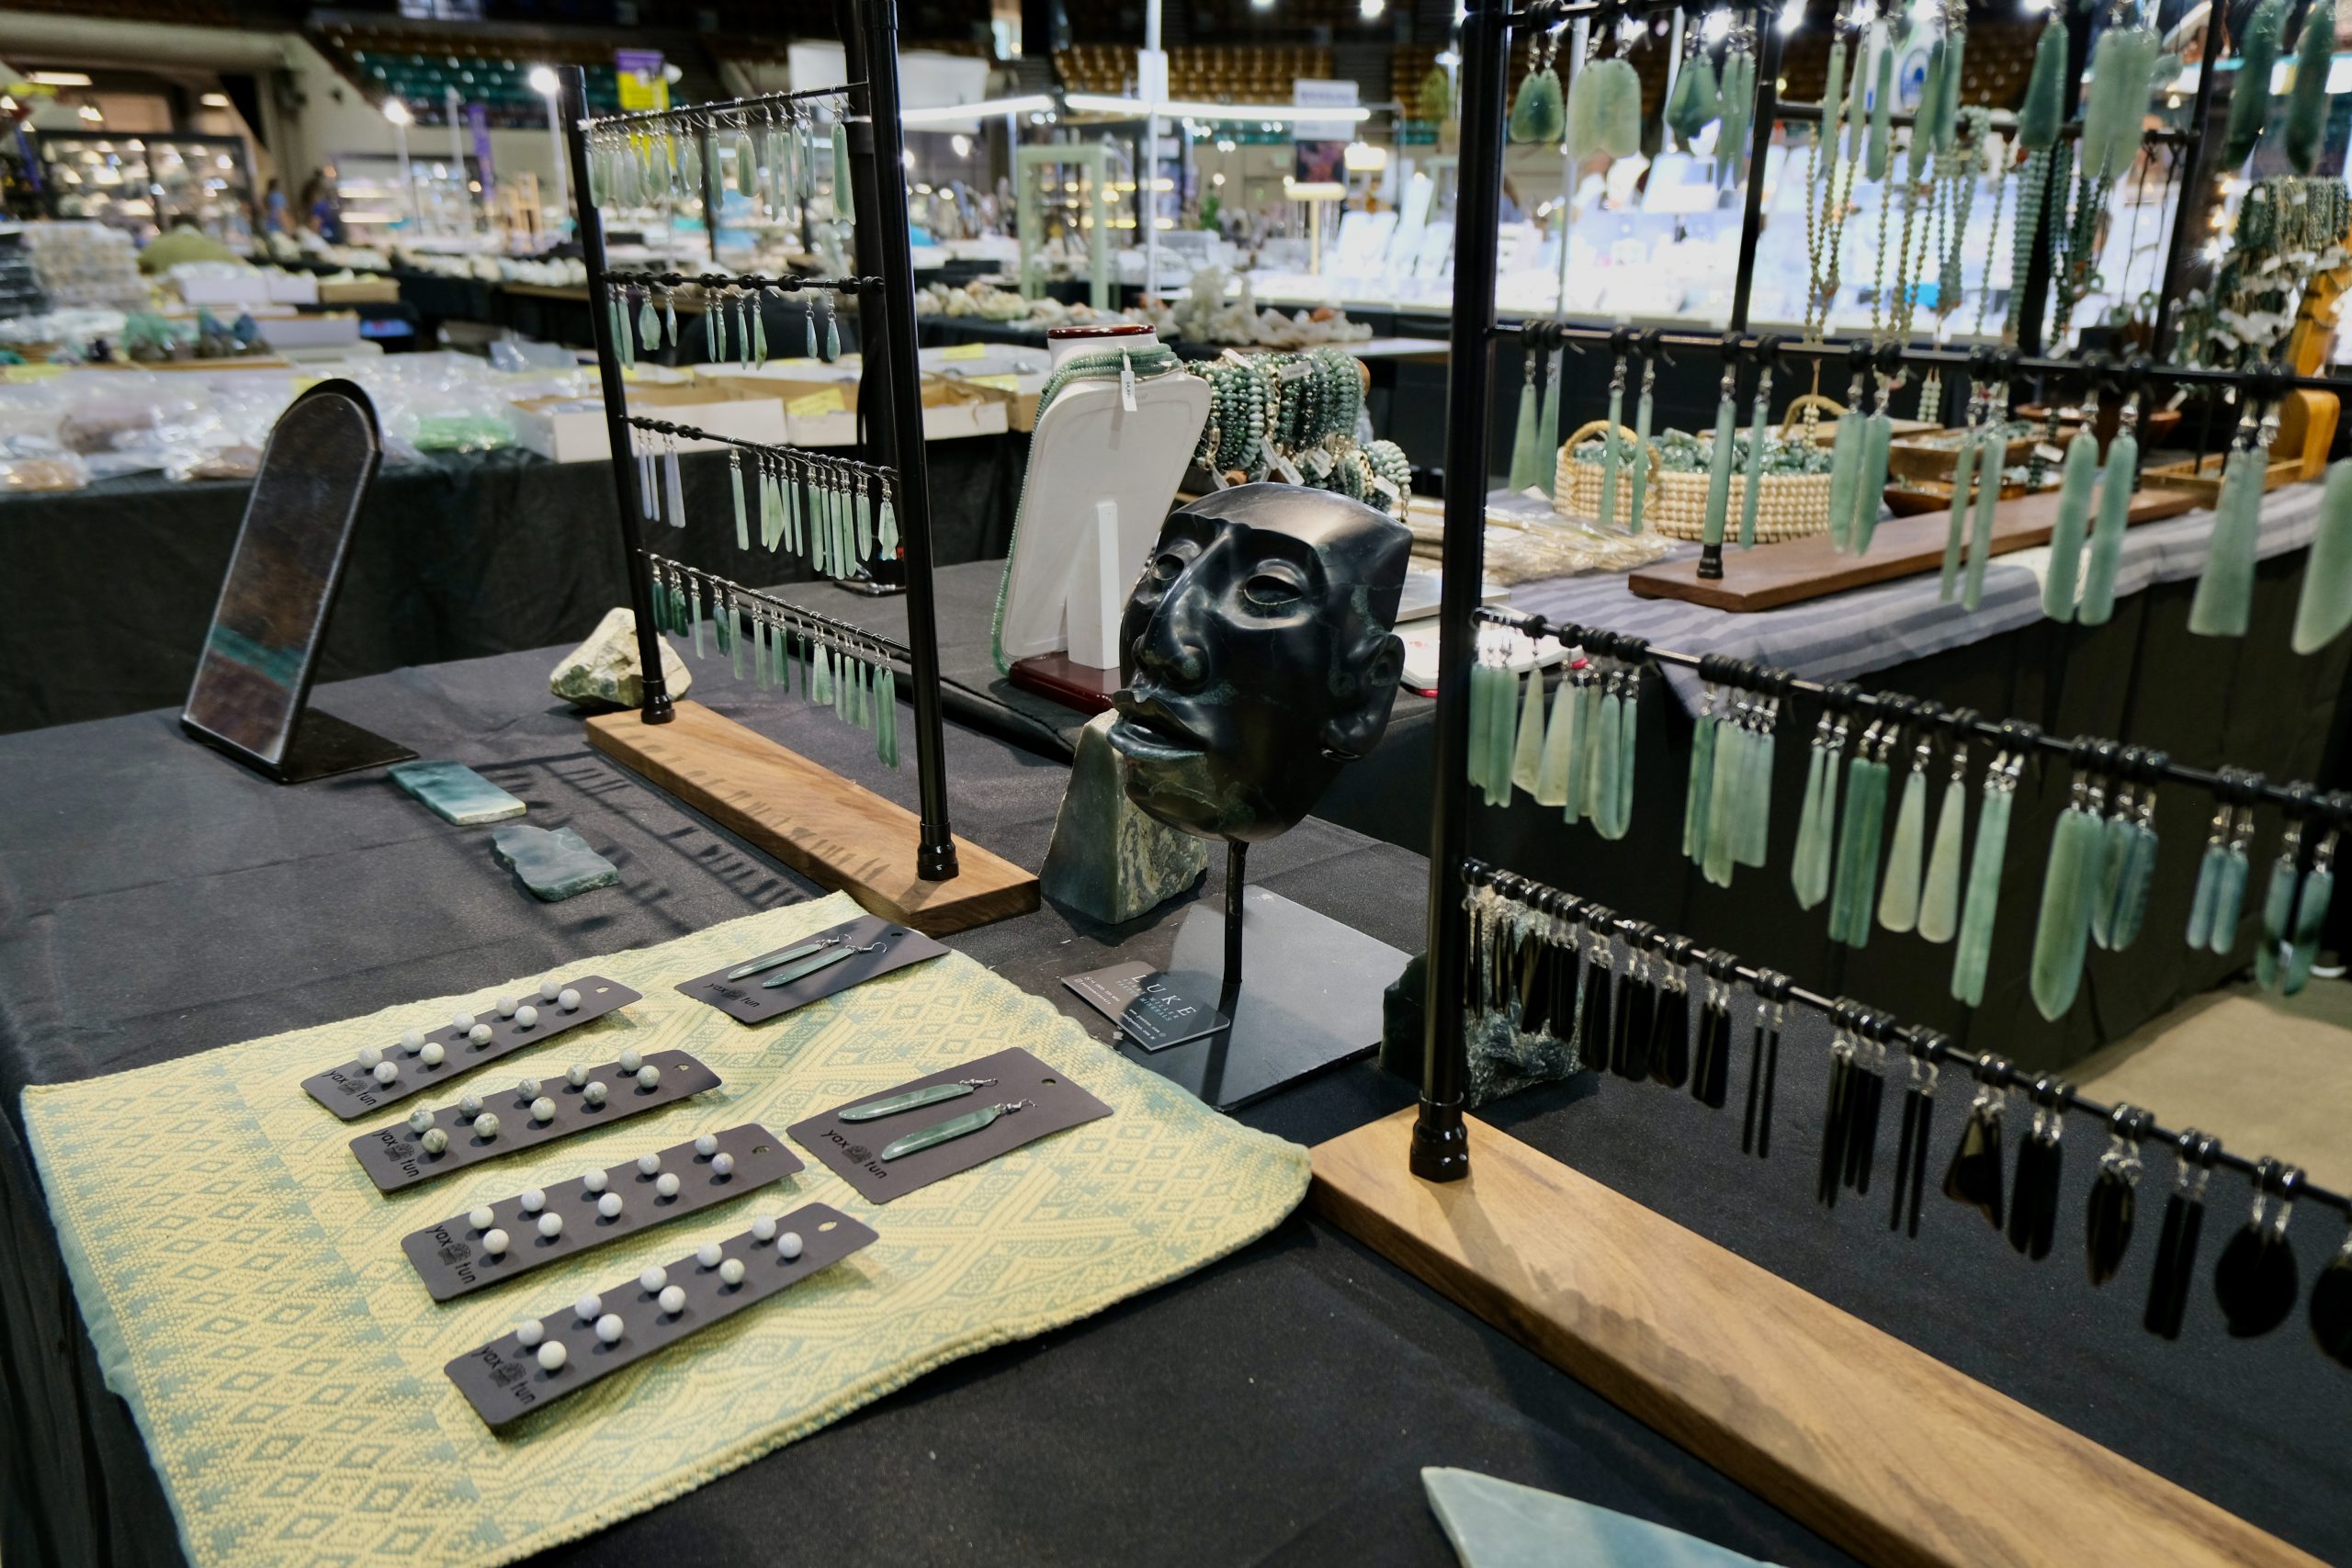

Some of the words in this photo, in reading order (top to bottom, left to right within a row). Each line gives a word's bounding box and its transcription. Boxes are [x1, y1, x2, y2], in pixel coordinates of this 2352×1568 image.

[703, 983, 729, 993] yax
[740, 997, 761, 1008] tun
[1131, 975, 1197, 1016] LUKE
[321, 1070, 349, 1085] yax
[356, 1090, 377, 1106] tun
[372, 1129, 398, 1146] yax
[400, 1158, 420, 1178] tun
[820, 1129, 851, 1148] yax
[864, 1160, 888, 1179] tun
[424, 1224, 453, 1247] yax
[455, 1261, 477, 1285] tun
[470, 1346, 504, 1370] yax
[510, 1380, 537, 1405] tun
